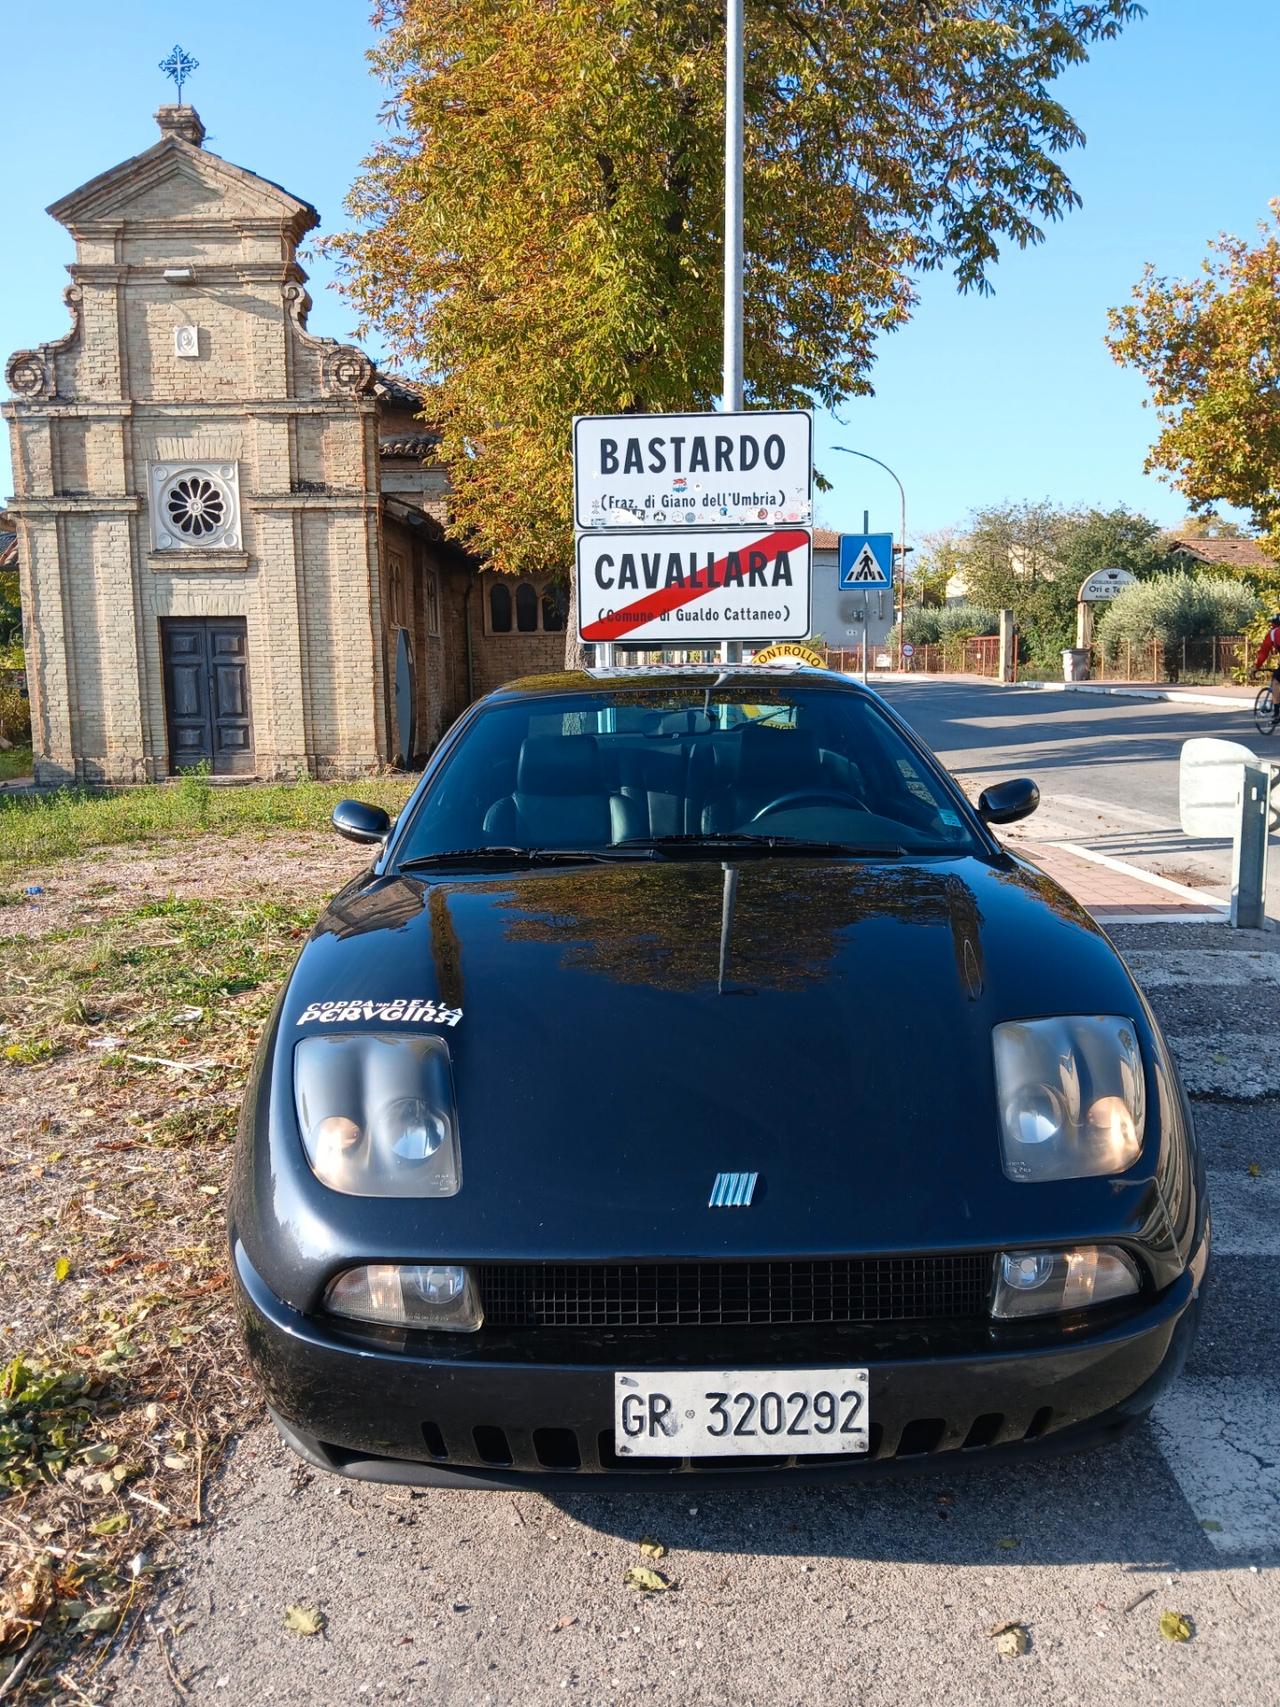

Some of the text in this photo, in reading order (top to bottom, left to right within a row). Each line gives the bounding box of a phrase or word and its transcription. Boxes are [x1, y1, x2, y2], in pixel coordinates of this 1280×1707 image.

[600, 433, 786, 475] BASTARDO
[601, 489, 786, 511] (Fraz. di Giano dell'Umbria)
[594, 551, 793, 590] CAVALLARA
[597, 605, 791, 624] (Comune di Gualdo Cattaneo)
[753, 645, 821, 667] ONTROLLO
[306, 999, 464, 1016] COPPA DELLA
[621, 1391, 864, 1437] GR 320292
